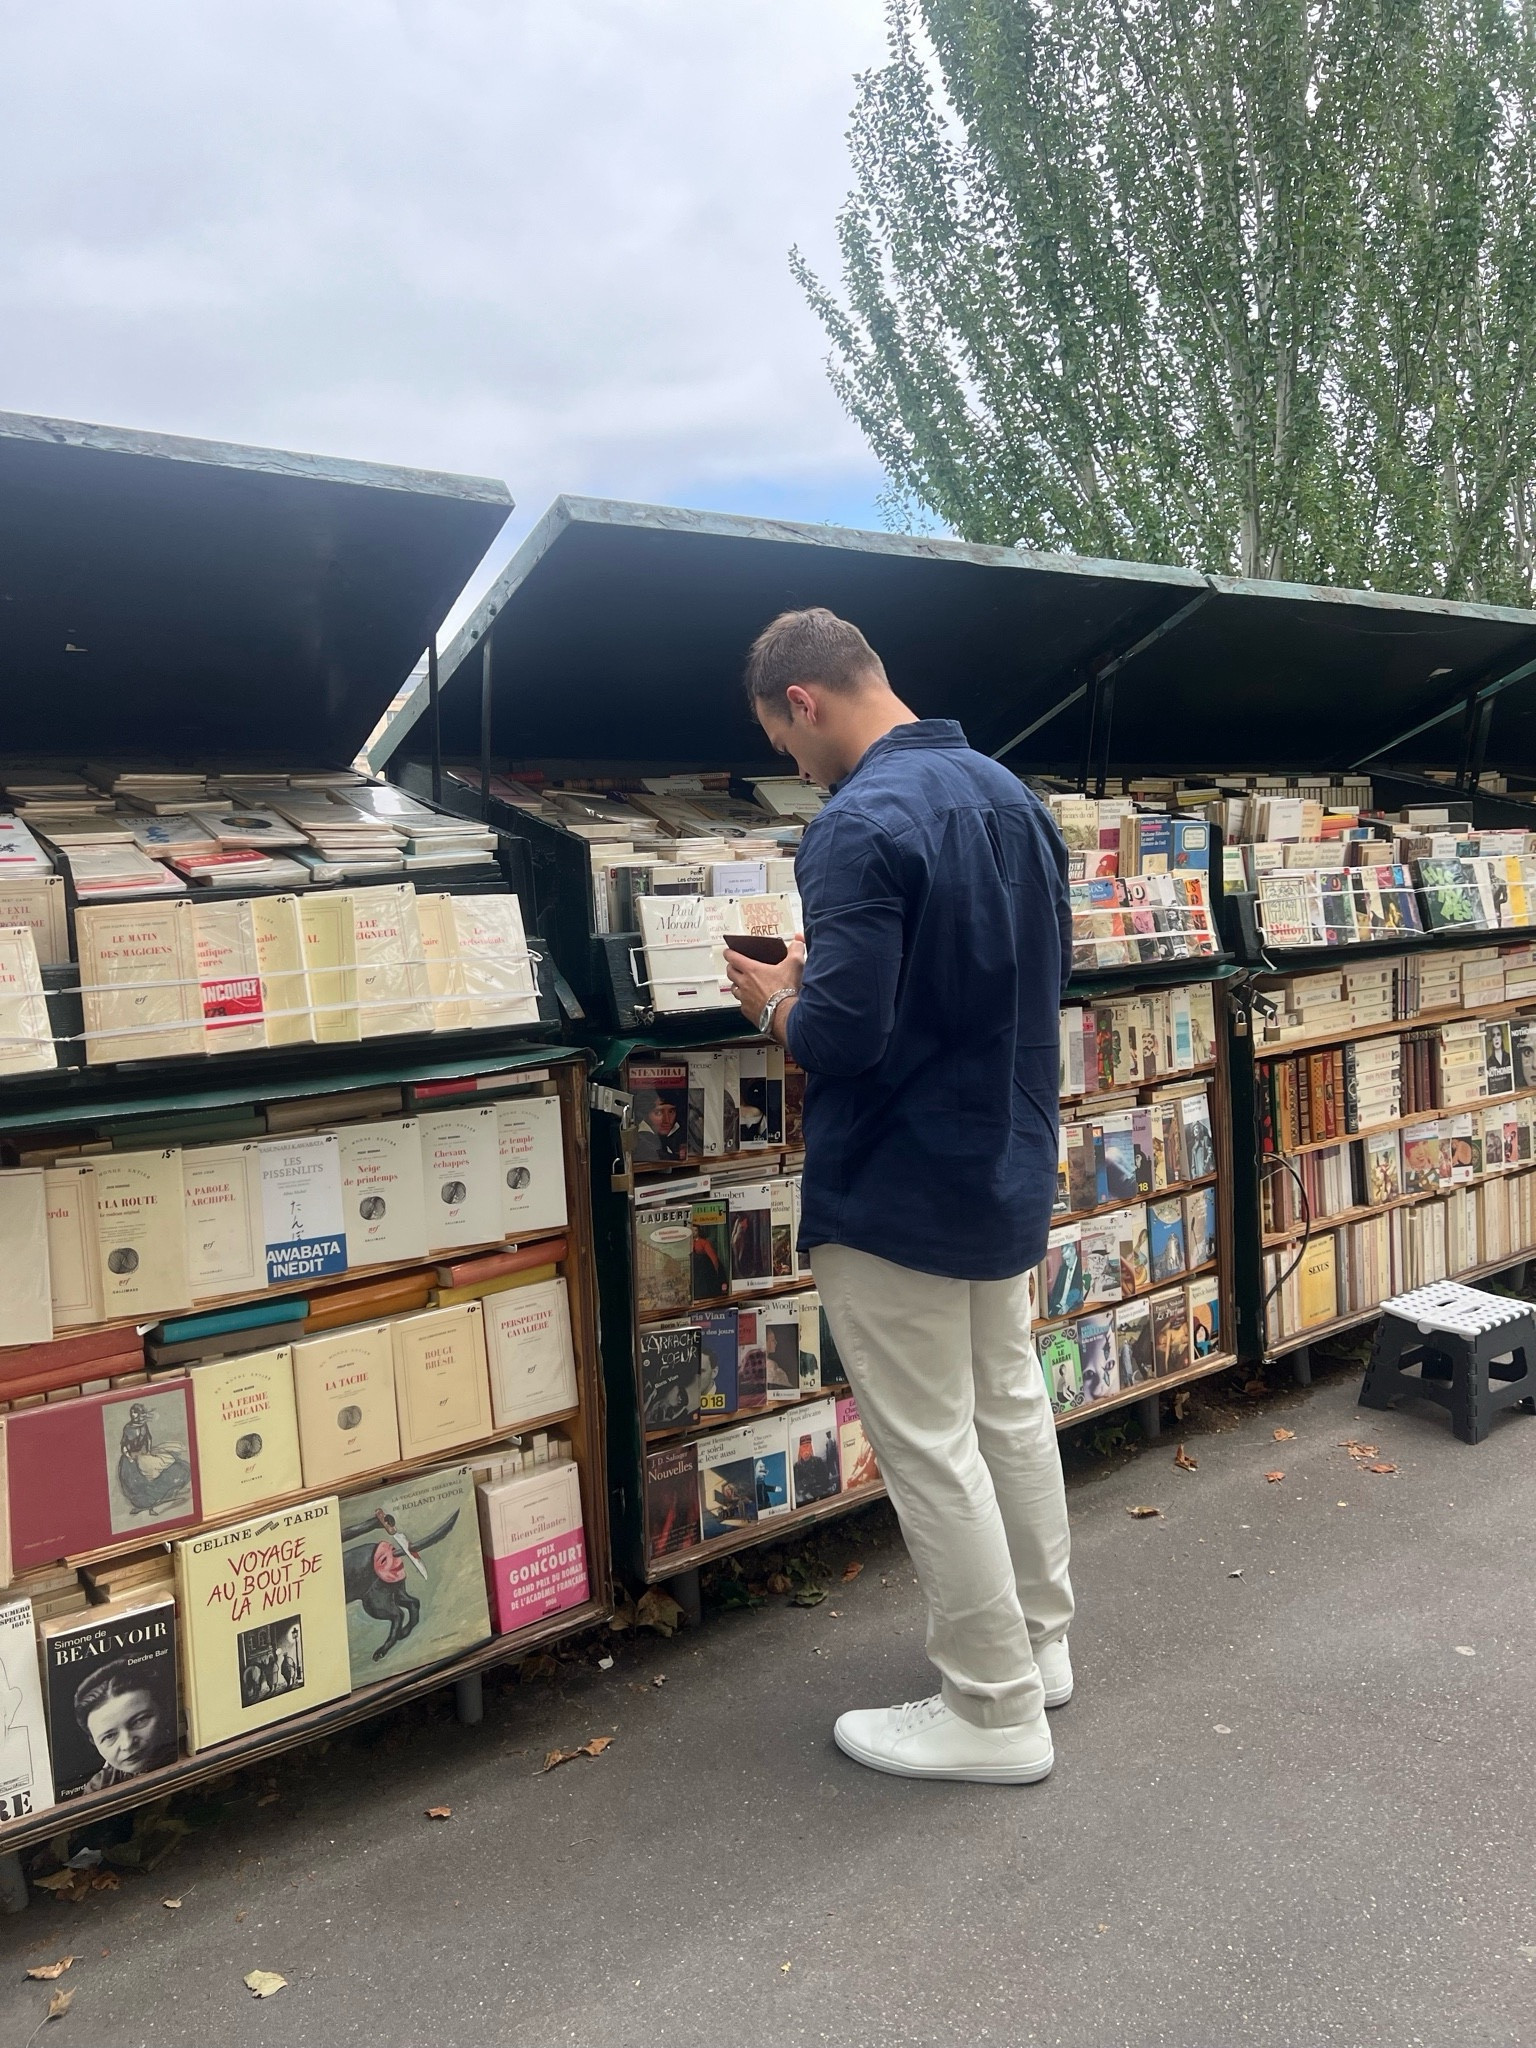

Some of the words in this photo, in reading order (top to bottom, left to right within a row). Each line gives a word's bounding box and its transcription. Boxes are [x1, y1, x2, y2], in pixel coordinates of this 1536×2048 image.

[44, 878, 63, 886] 10-
[656, 916, 702, 931] Morand
[112, 935, 125, 944] LE
[128, 932, 158, 944] MATIN
[100, 950, 119, 960] DES
[122, 946, 173, 958] MAGICIENS
[630, 1066, 686, 1078] STENDHAL
[509, 1135, 535, 1146] temple
[162, 1150, 175, 1159] 15-
[434, 1148, 467, 1159] Chevaux
[283, 1157, 302, 1167] LES
[433, 1158, 470, 1169] échappés
[262, 1164, 324, 1180] PISSENLITS
[358, 1164, 381, 1174] Neige
[343, 1178, 354, 1187] de
[356, 1174, 398, 1187] printemps
[1138, 1182, 1149, 1192] 18
[195, 1184, 230, 1196] PAROLE
[761, 1186, 770, 1194] 5-
[105, 1199, 118, 1209] LA
[121, 1195, 158, 1208] ROUTE
[191, 1195, 236, 1207] ARCHIPEL
[266, 1241, 341, 1265] AWABATA
[1308, 1261, 1330, 1276] SEXUS
[467, 1306, 481, 1314] 10-
[772, 1301, 794, 1310] Woolf
[501, 1309, 554, 1330] PERSPECTIVE
[705, 1312, 726, 1321] Vian
[718, 1328, 735, 1336] jours
[277, 1353, 288, 1361] 10-
[1058, 1349, 1065, 1357] LE
[325, 1381, 337, 1391] LA
[339, 1372, 369, 1387] TACHE
[222, 1400, 234, 1412] LA
[237, 1391, 269, 1407] FERME
[712, 1395, 724, 1408] 18
[221, 1401, 271, 1421] AFRICAINE
[706, 1443, 725, 1454] soleil
[720, 1449, 737, 1460] aussi
[665, 1451, 688, 1464] Salinger
[458, 1466, 472, 1475] 15-
[648, 1460, 694, 1484] Nouvelles
[402, 1496, 436, 1511] ROLAND
[437, 1487, 464, 1501] TOPOR
[193, 1528, 252, 1554] CELINE
[284, 1505, 329, 1527] TARDI
[511, 1516, 566, 1543] Bienveillantes
[228, 1536, 306, 1576] VOYAGE
[536, 1543, 555, 1558] PRIX
[509, 1543, 583, 1585] GONCOURT
[207, 1581, 236, 1607] AU
[242, 1563, 293, 1596] BOUT
[300, 1553, 323, 1578] DE
[513, 1582, 535, 1599] GRAND
[536, 1576, 551, 1589] PRIX
[551, 1572, 561, 1583] DU
[561, 1562, 583, 1579] ROMAN
[231, 1596, 251, 1622] LA
[263, 1579, 305, 1611] NUIT
[511, 1601, 519, 1611] DE
[12, 1621, 24, 1630] 160
[54, 1631, 93, 1650] Simone
[94, 1629, 107, 1640] de
[55, 1621, 168, 1667] BEAUVOIR
[127, 1653, 154, 1666] Deirdre
[155, 1648, 169, 1658] Bair
[61, 1785, 88, 1798] Fayard
